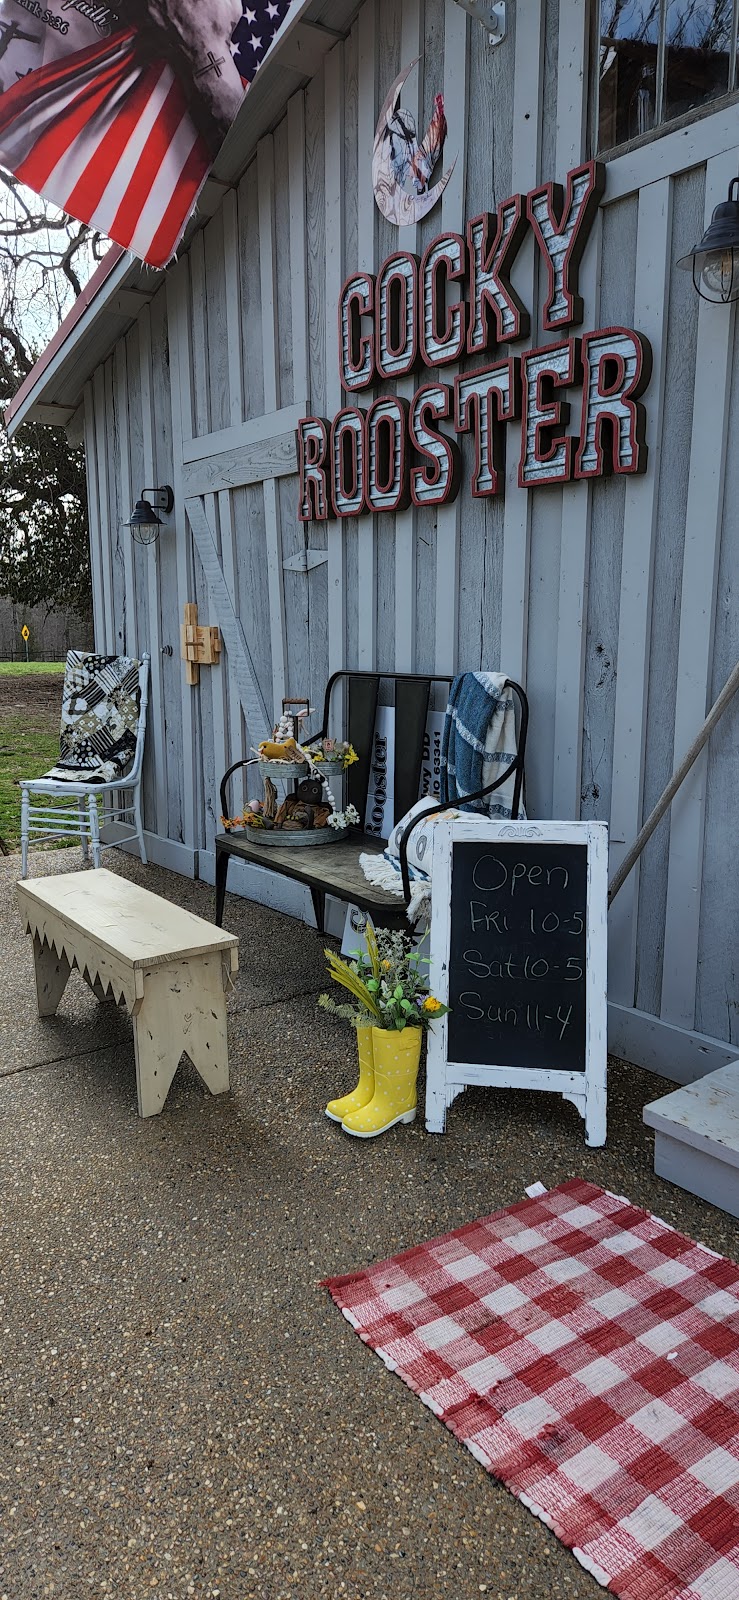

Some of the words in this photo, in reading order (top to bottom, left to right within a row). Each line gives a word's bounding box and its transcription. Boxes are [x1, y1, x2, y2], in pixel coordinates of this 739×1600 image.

[16, 0, 42, 18] ark
[42, 10, 69, 35] 5:36
[337, 160, 605, 392] COCKY
[298, 326, 652, 522] ROOSTER
[433, 731, 441, 775] 63341
[472, 854, 569, 896] Open
[530, 909, 584, 935] 10-5
[462, 949, 517, 979] Sat
[523, 955, 584, 981] 10-5
[458, 991, 518, 1026] Sun
[526, 1004, 573, 1040] 11-4
